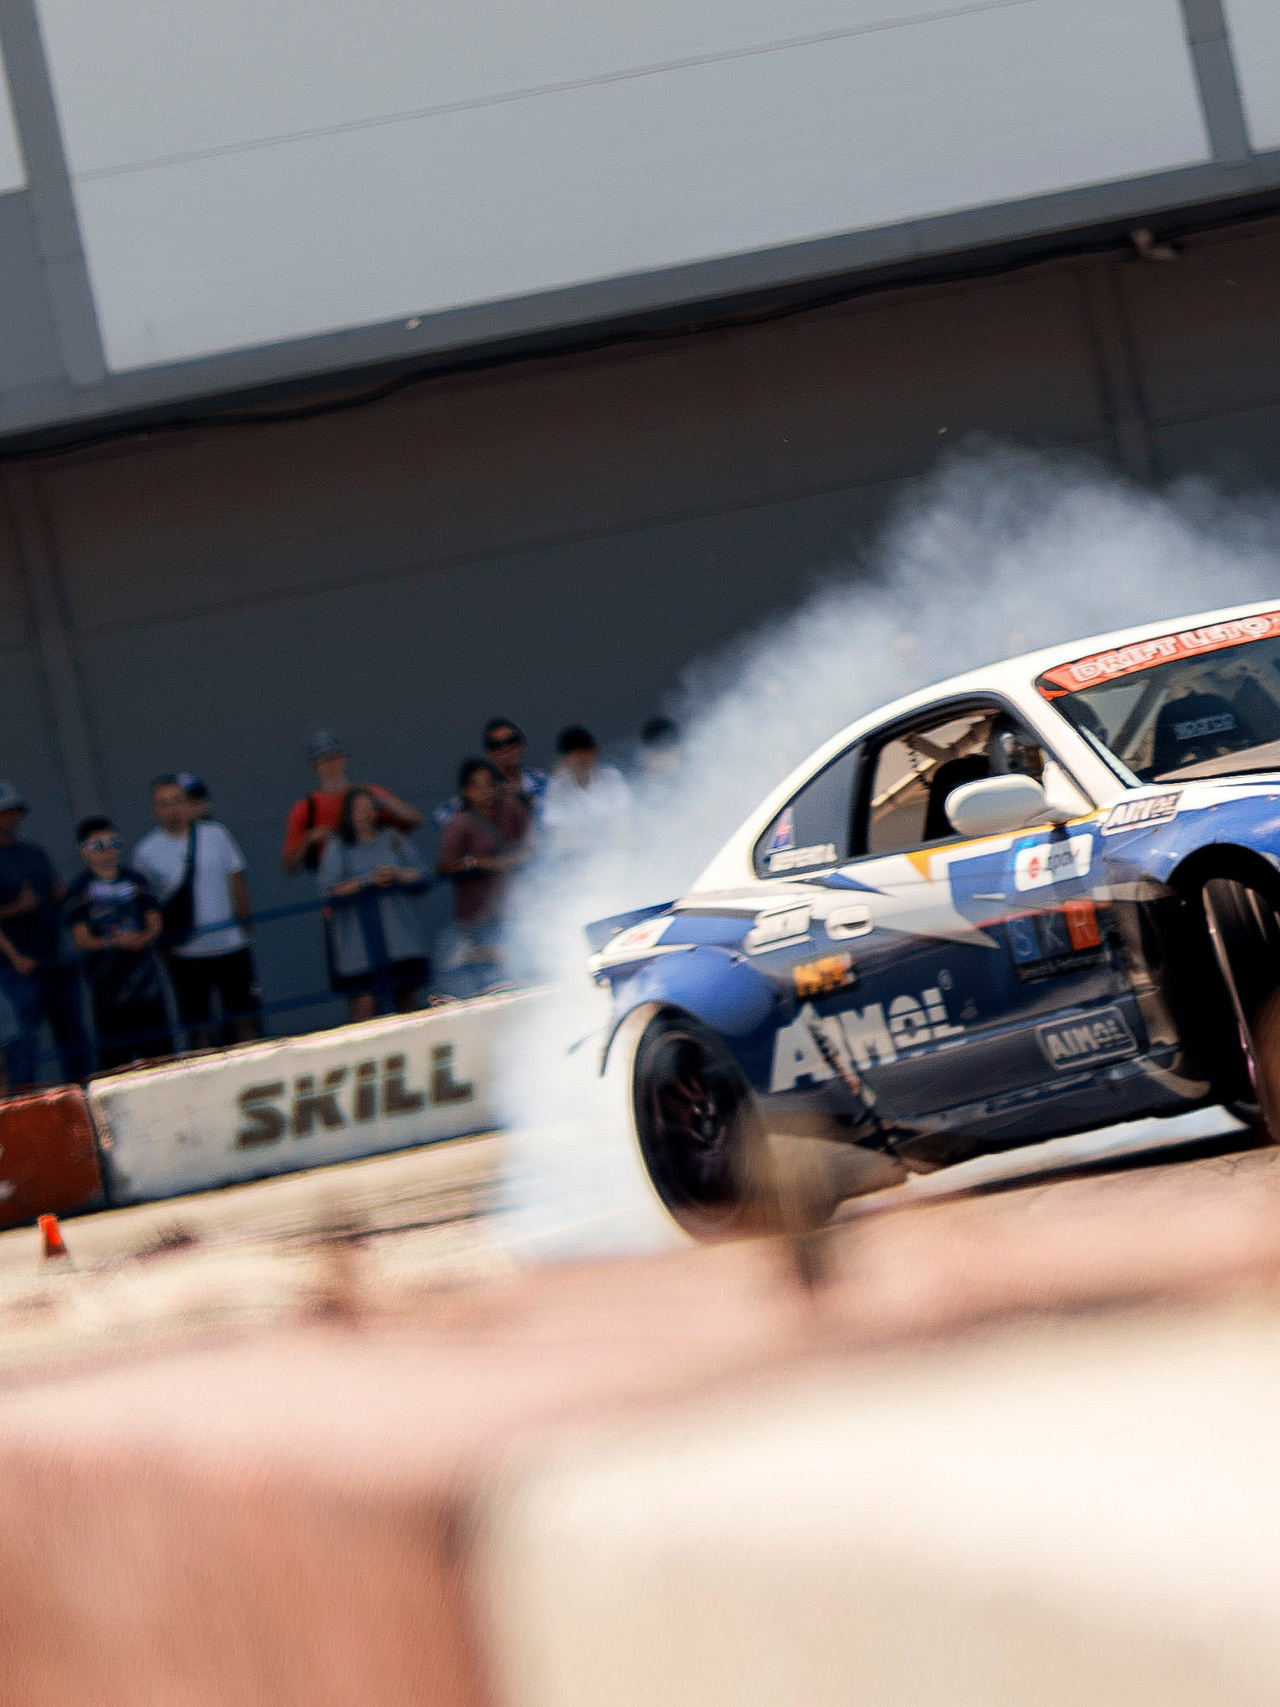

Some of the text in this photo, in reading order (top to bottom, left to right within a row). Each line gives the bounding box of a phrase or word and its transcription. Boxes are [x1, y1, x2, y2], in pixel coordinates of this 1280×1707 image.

[1069, 636, 1178, 683] DRIFT
[770, 987, 966, 1094] AIMOL
[235, 1042, 474, 1150] SKILL
